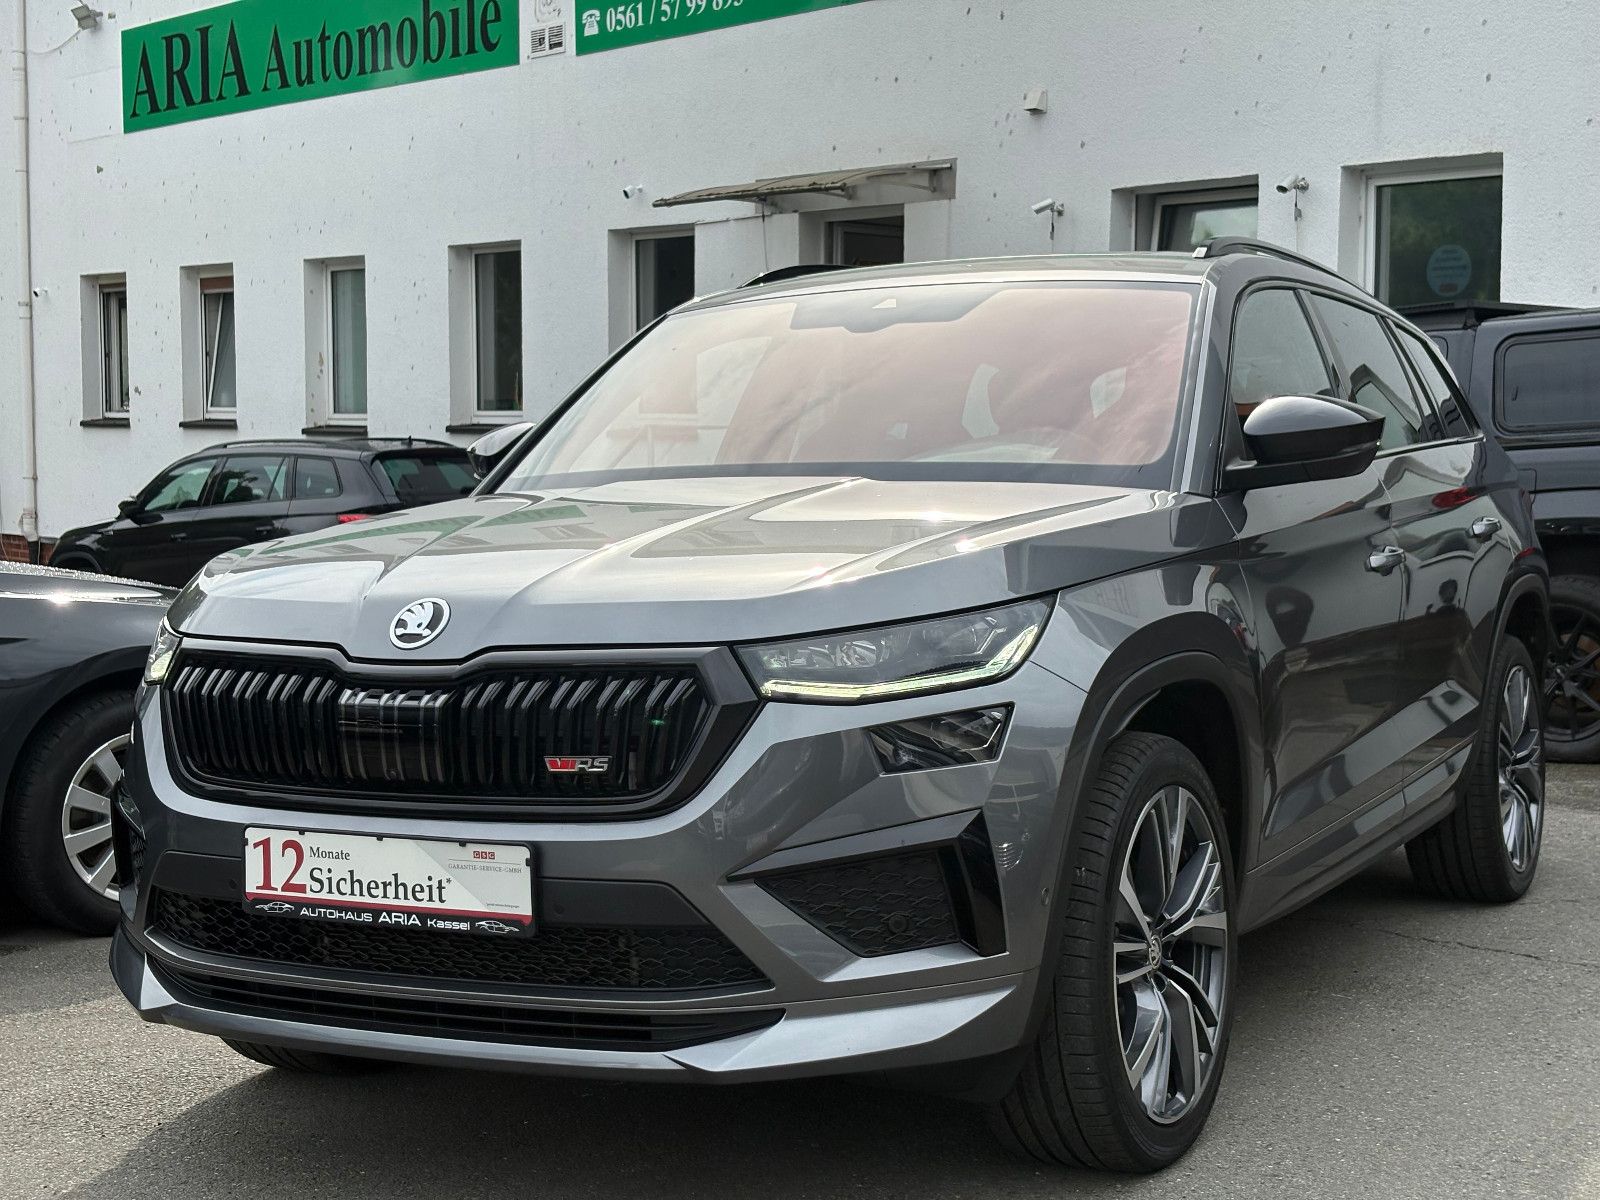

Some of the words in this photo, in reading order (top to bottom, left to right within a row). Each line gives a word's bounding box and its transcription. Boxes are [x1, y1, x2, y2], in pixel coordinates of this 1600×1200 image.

[606, 2, 644, 33] 0561
[130, 19, 251, 119] ARIA
[261, 0, 503, 92] Automobile
[252, 836, 307, 895] 12
[309, 846, 351, 861] Monate
[300, 907, 373, 922] AUTOHAUS
[378, 911, 422, 927] ARIA
[427, 918, 471, 931] Kassel
